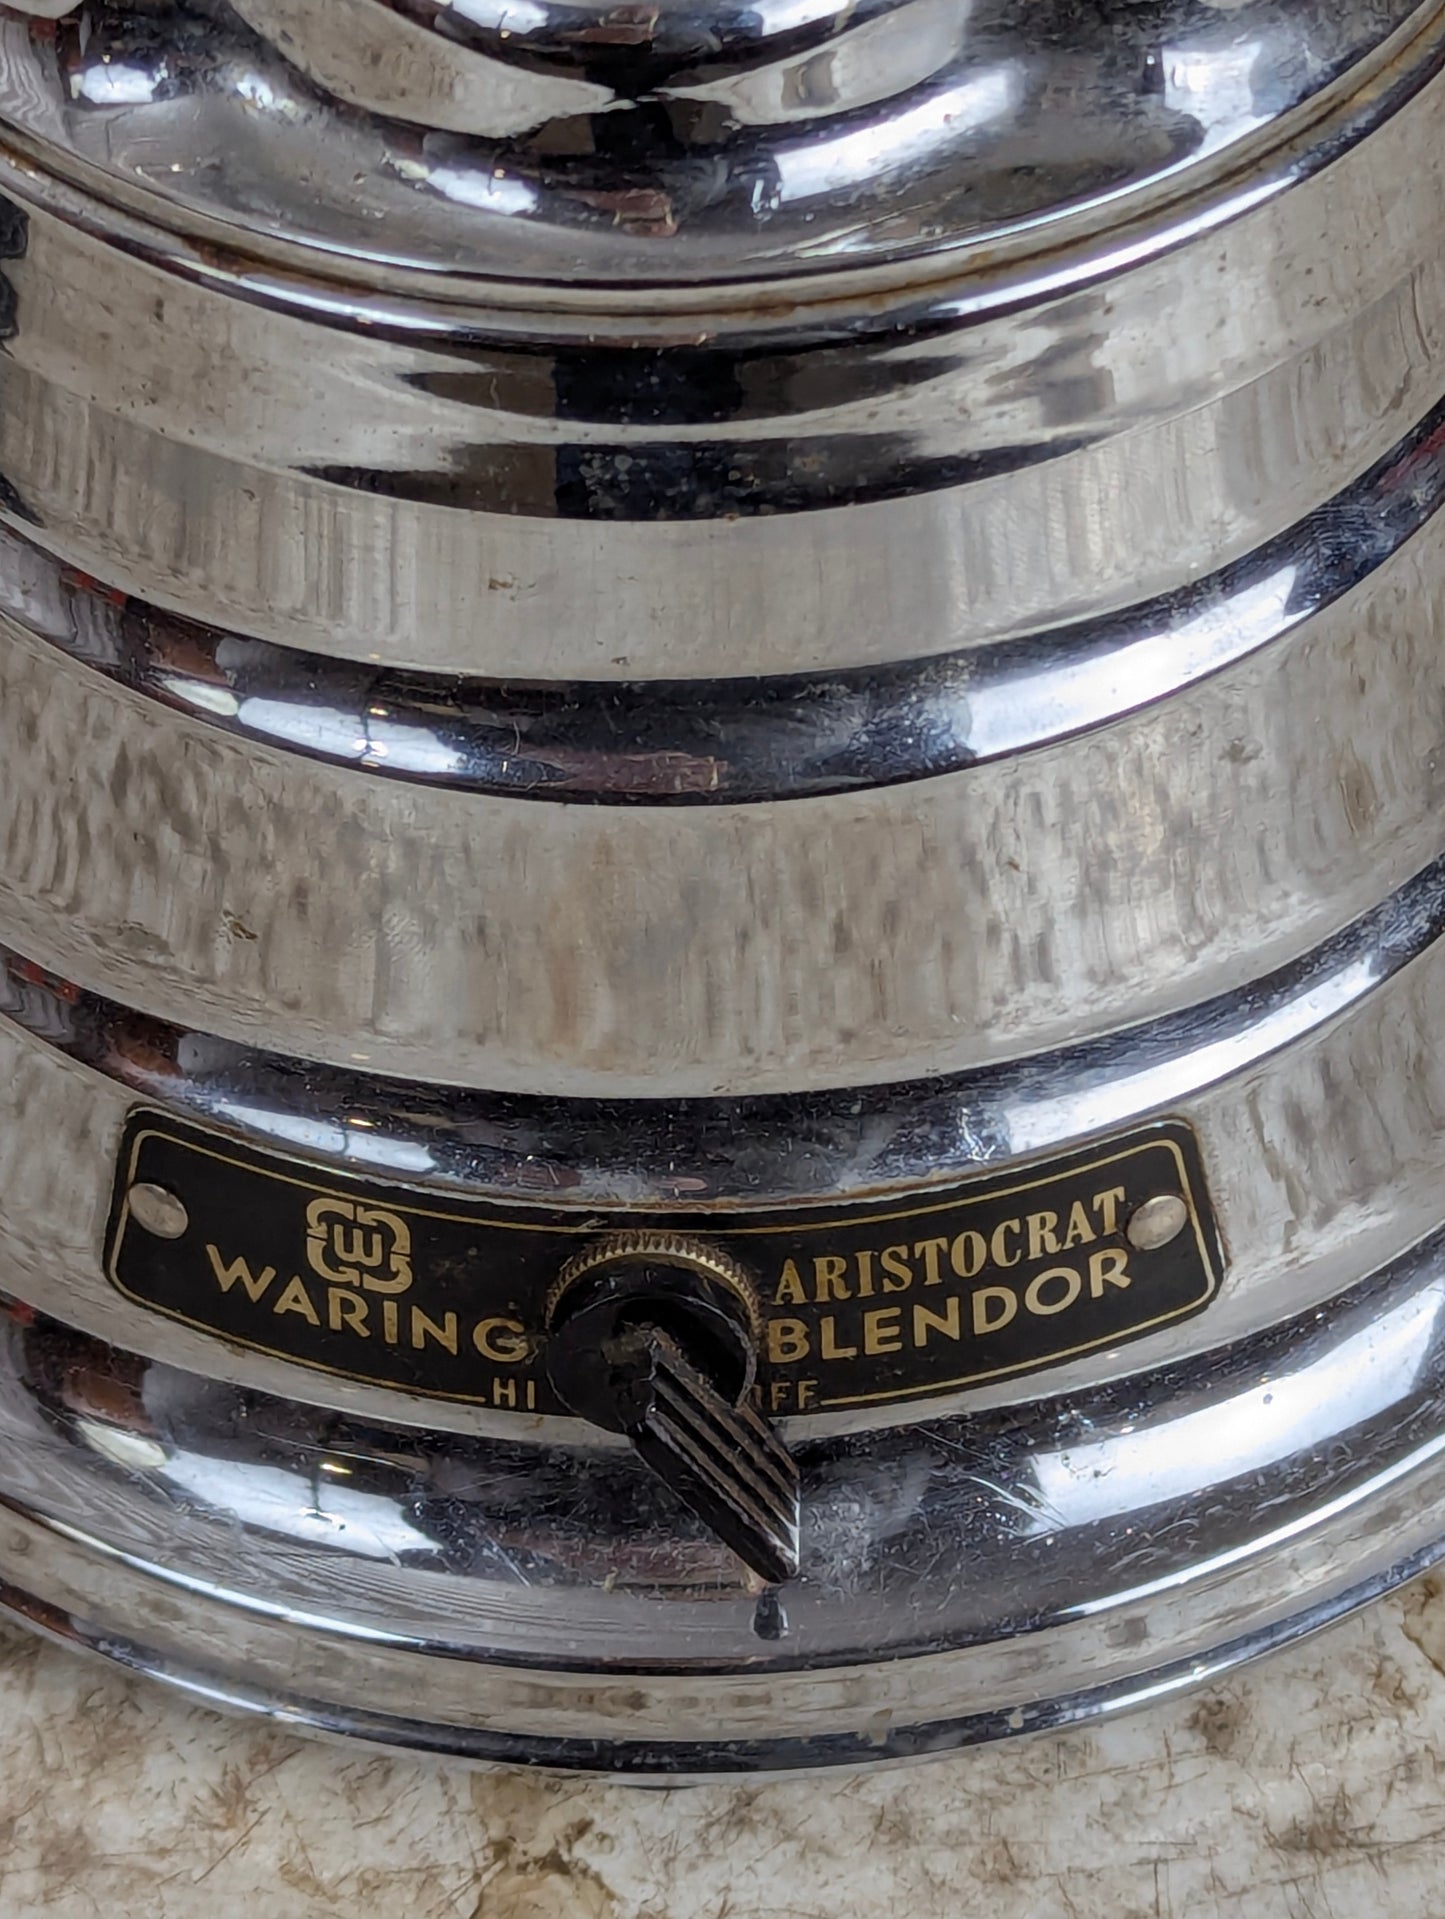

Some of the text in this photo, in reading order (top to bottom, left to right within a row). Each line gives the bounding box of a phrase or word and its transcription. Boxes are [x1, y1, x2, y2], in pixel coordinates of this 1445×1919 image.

[206, 1244, 1132, 1363] WARING BLENDOR
[774, 1186, 1126, 1306] ARISTOCRAT
[492, 1377, 535, 1410] HI
